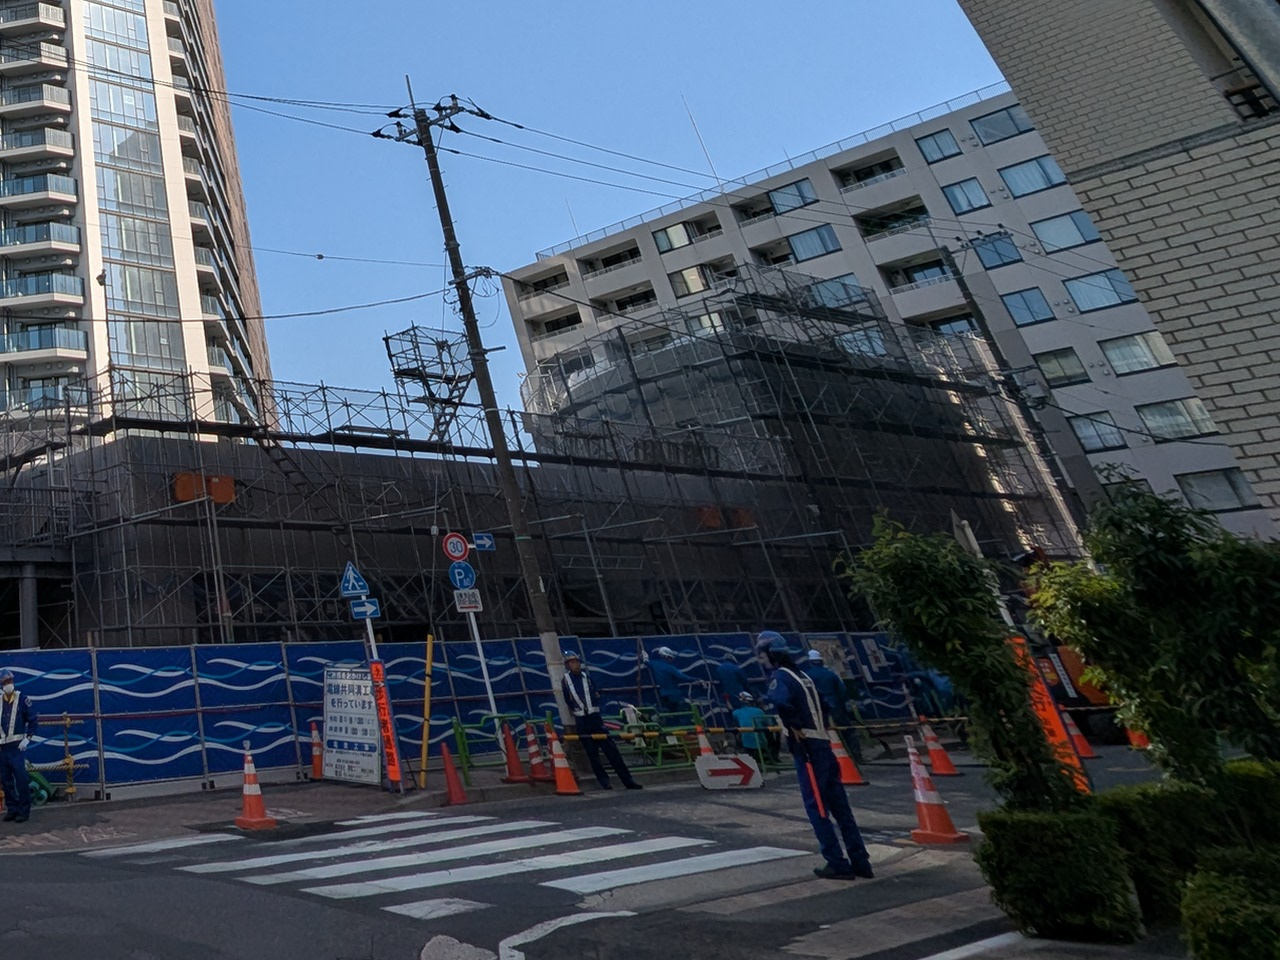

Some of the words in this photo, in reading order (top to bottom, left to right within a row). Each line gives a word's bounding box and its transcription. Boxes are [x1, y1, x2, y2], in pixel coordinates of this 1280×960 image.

[449, 541, 463, 553] 30
[455, 569, 464, 586] P
[328, 683, 374, 696] 電線共同溝工
[331, 698, 373, 709] を行っています
